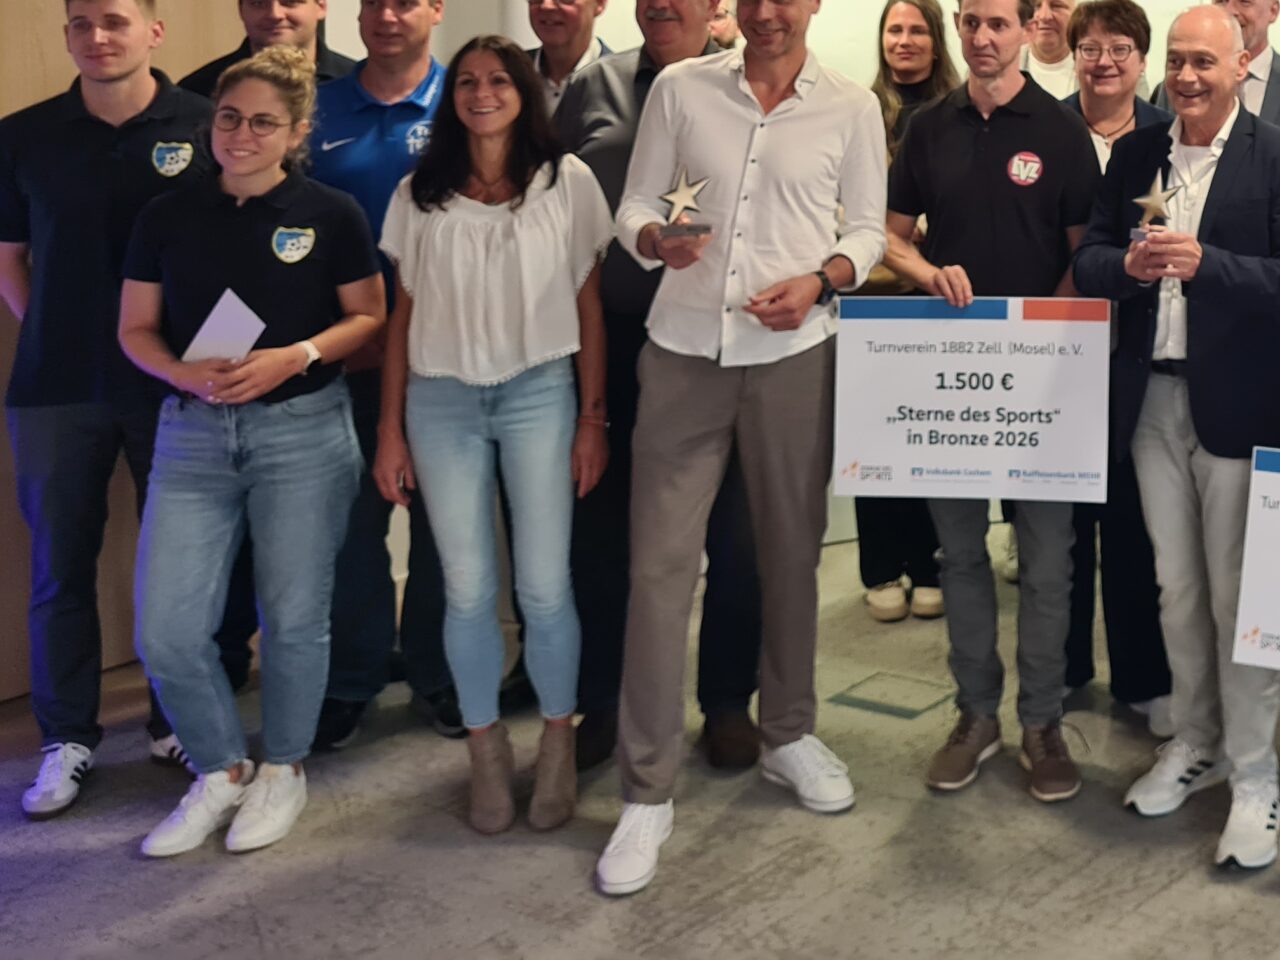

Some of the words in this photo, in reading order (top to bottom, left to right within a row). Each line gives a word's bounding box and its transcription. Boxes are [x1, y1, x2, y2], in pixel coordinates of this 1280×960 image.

[866, 341, 937, 354] Turnverein
[941, 342, 974, 354] 1882
[977, 342, 1002, 354] Zell
[1008, 342, 1056, 356] (Mosel)
[1058, 346, 1070, 355] e.
[1072, 344, 1084, 355] V.
[935, 372, 994, 390] 1.500
[1001, 373, 1014, 390] €
[886, 406, 955, 424] „Sterne
[960, 406, 990, 423] des
[995, 407, 1061, 426] Sports“
[907, 429, 923, 445] in
[928, 430, 989, 446] Bronze
[994, 431, 1040, 447] 2026
